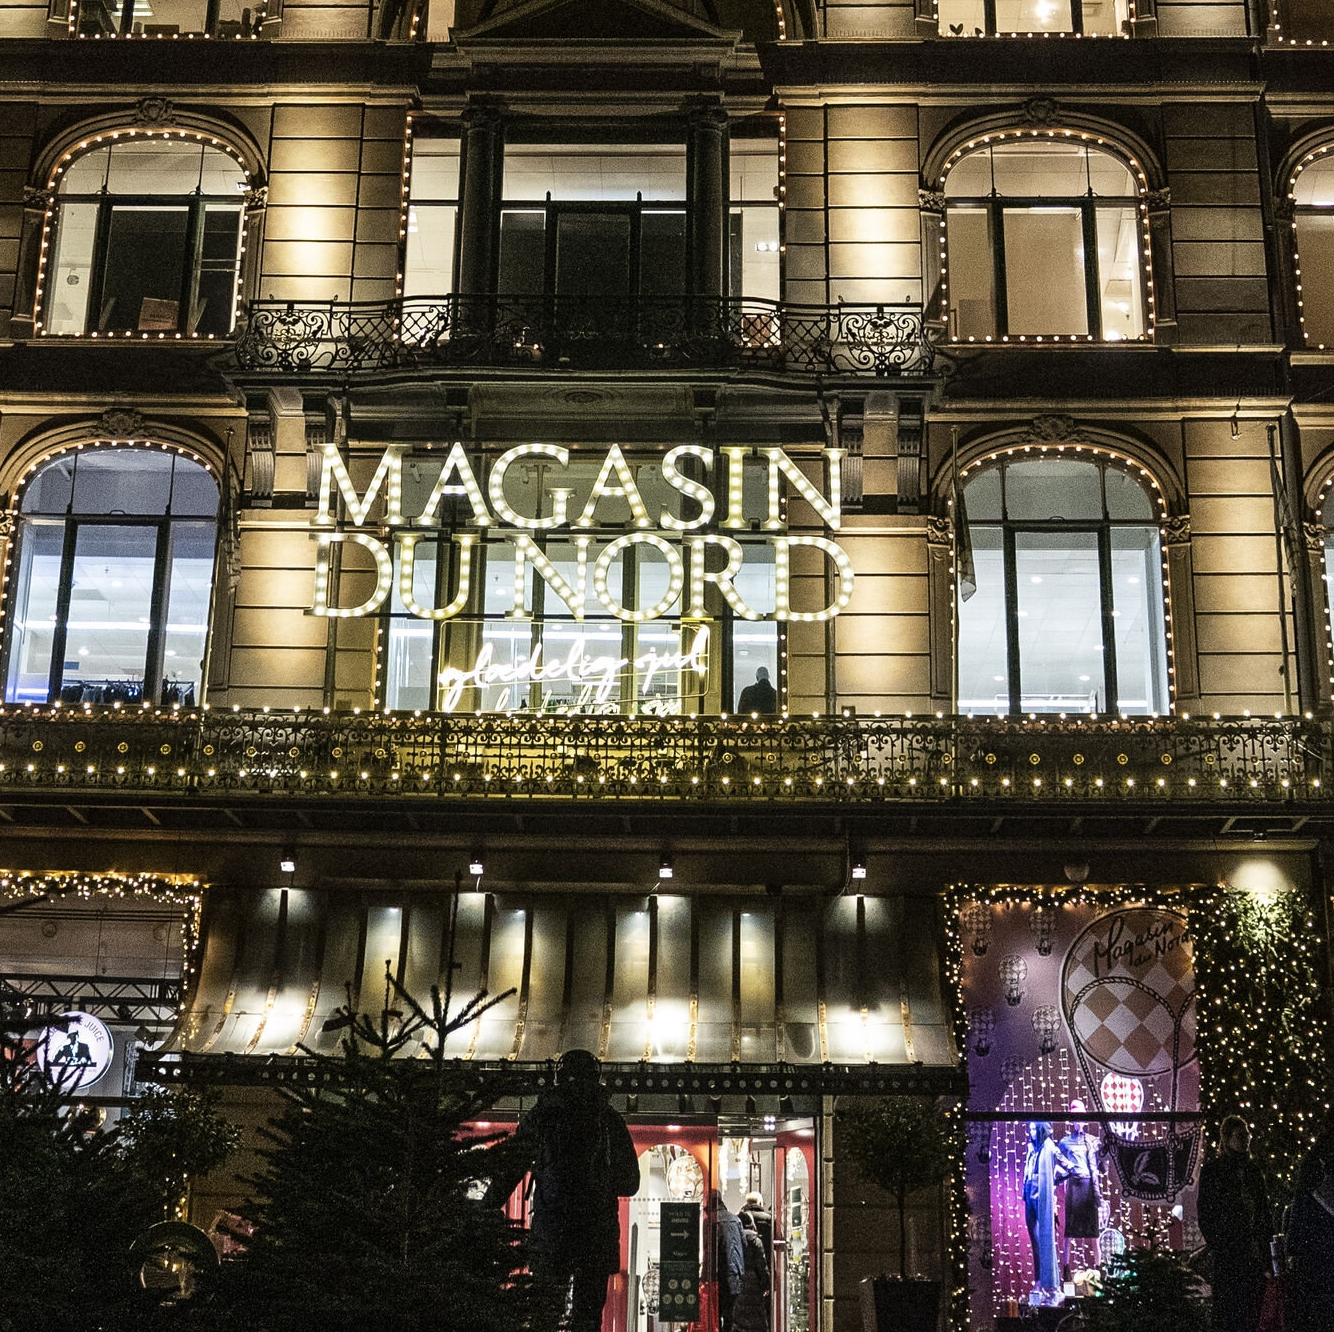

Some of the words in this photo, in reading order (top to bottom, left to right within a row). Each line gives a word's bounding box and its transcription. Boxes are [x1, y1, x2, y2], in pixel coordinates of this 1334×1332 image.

[310, 441, 848, 531] MAGASIN
[304, 531, 480, 618] DU
[505, 532, 855, 621] NORD
[1093, 915, 1174, 978] Magasin
[84, 1021, 105, 1043] JUICE
